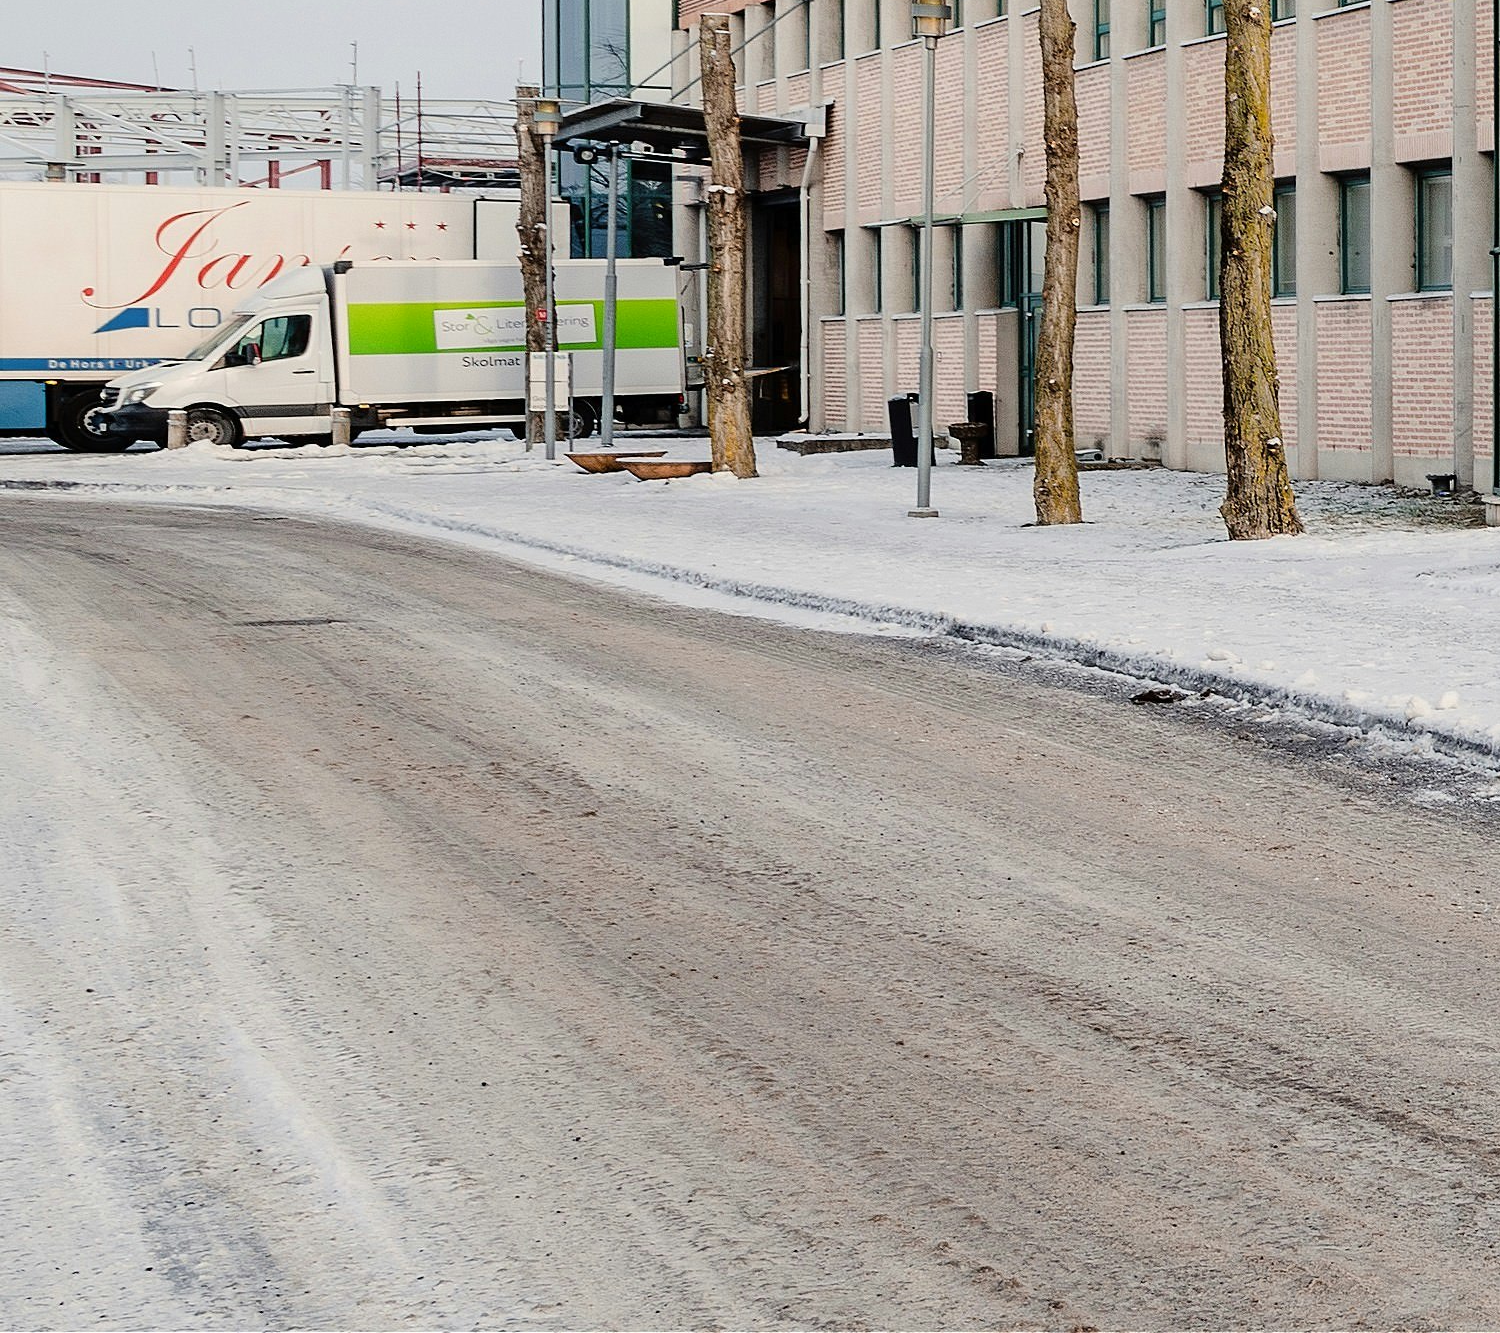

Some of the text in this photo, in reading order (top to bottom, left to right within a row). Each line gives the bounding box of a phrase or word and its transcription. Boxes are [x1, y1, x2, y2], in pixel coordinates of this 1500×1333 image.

[441, 320, 470, 333] Stor
[474, 315, 495, 336] &
[556, 315, 590, 328] ering
[461, 355, 521, 368] Skolmat
